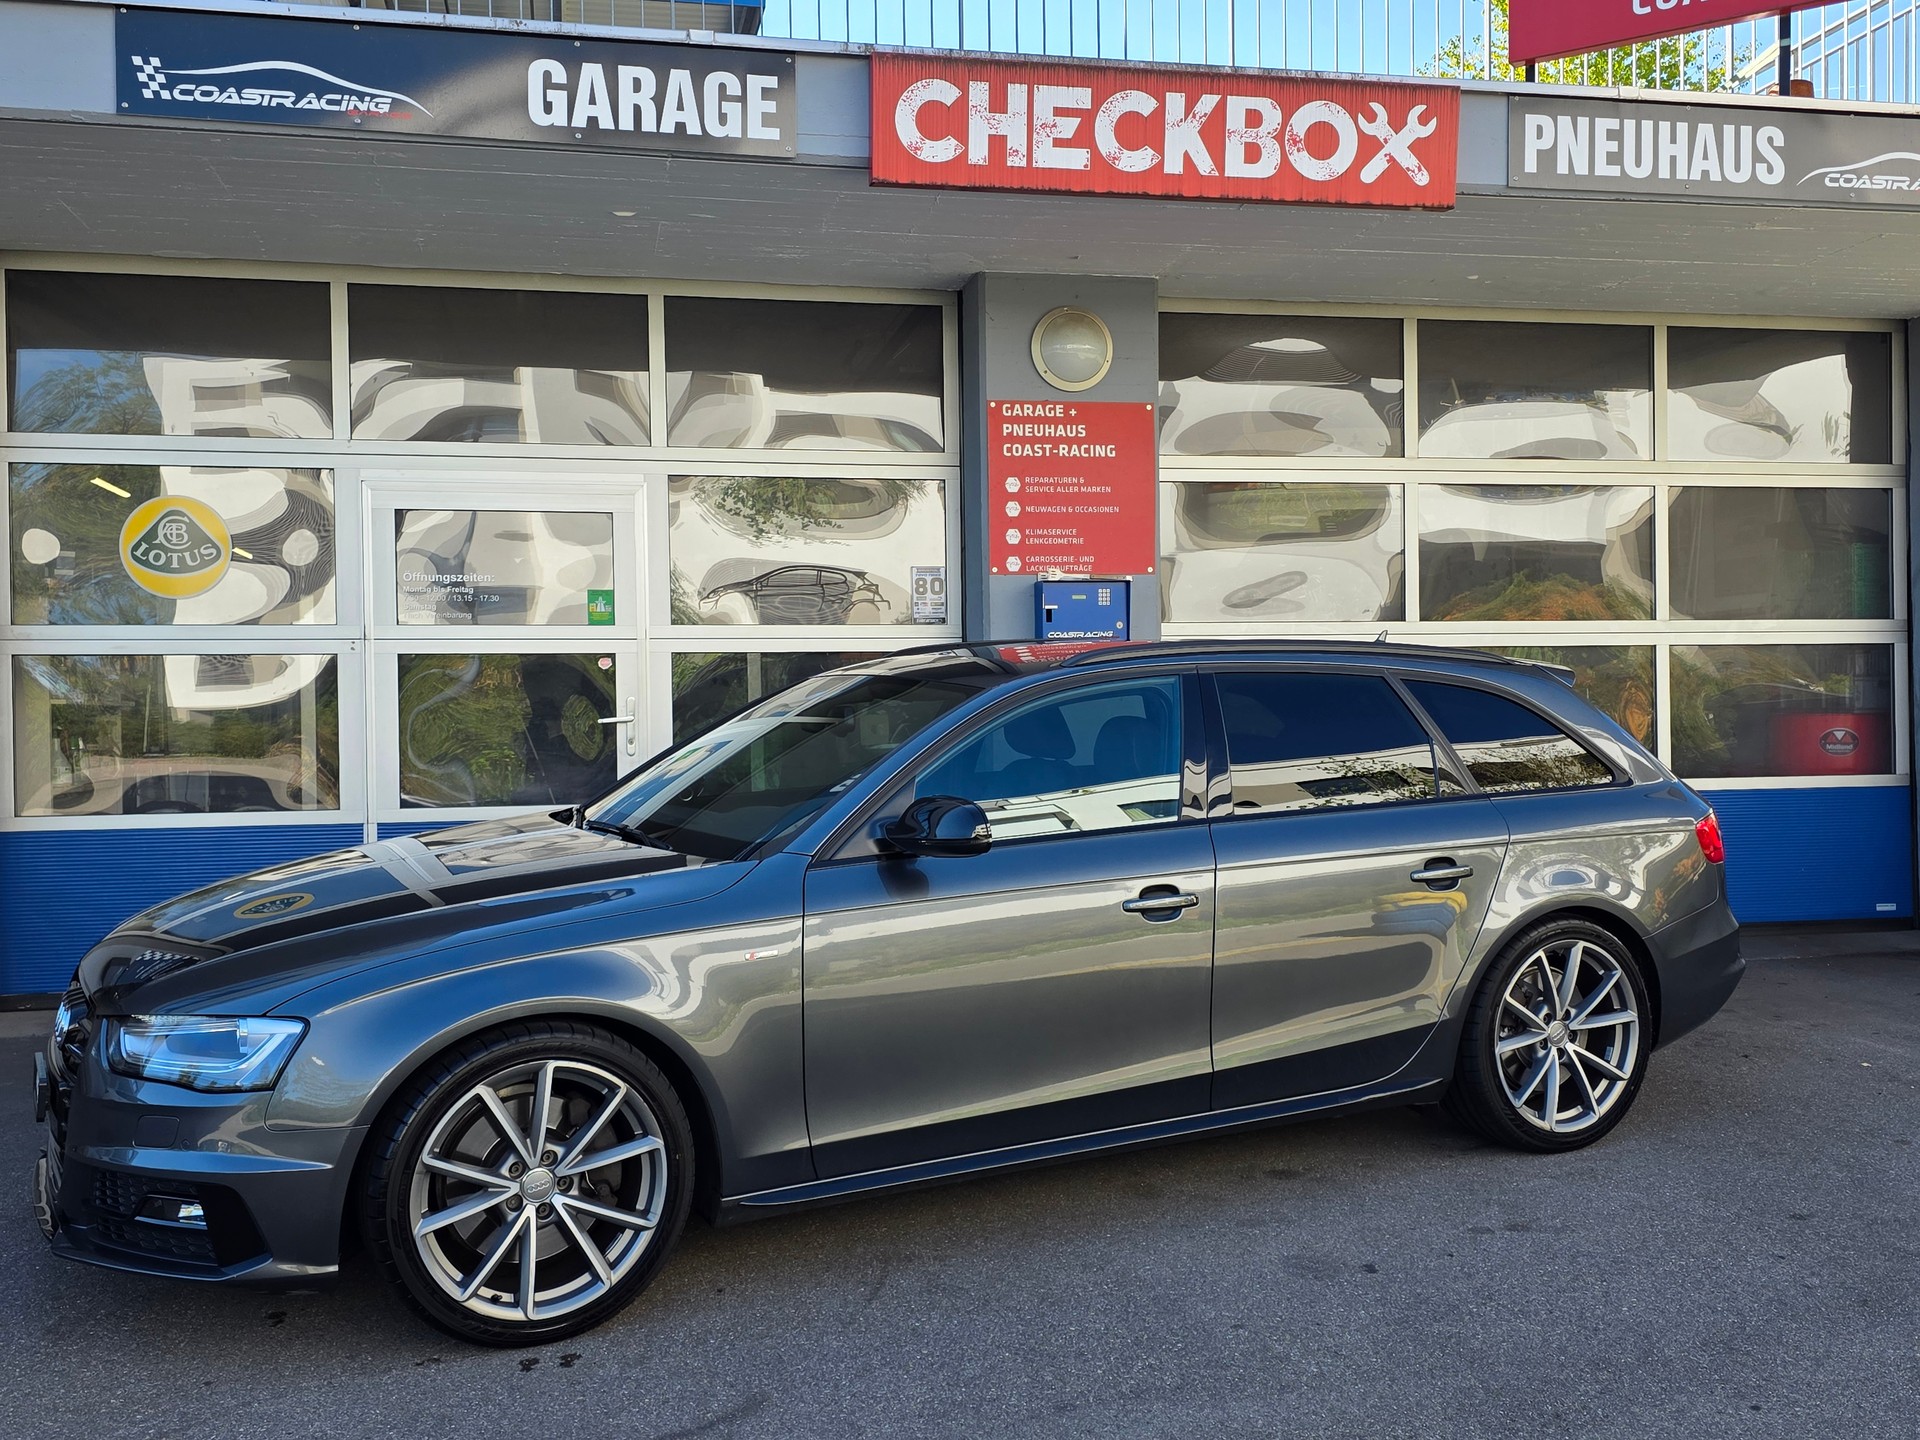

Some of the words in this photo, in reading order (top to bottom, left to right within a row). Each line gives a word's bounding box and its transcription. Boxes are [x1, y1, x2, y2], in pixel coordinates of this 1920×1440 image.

[172, 83, 393, 114] COASTRACING
[527, 58, 781, 141] GARAGE
[895, 77, 1437, 187] CHECKBOX
[1524, 113, 1786, 186] PNEUHAUS
[1002, 403, 1064, 417] GARAGE
[1069, 408, 1077, 417] +
[1002, 423, 1086, 437] PNEUHAUS
[1002, 443, 1116, 458] COAST-RACING
[1025, 476, 1078, 484] REPARATUREN
[1025, 505, 1067, 513] NEUWAGEN
[1074, 505, 1120, 513] OCCASIONEN
[1025, 528, 1077, 536] KLIMASERVICE
[1025, 537, 1085, 545] LENKGEOMETRIE
[133, 541, 217, 568] LOTUS
[403, 571, 495, 584] Öffnungszeiten:
[403, 586, 432, 594] Montag
[447, 586, 474, 594] Freitag
[914, 577, 944, 595] 80
[453, 594, 473, 602] 13.15
[480, 594, 500, 602] 17.30
[1047, 630, 1114, 638] COASTRACING
